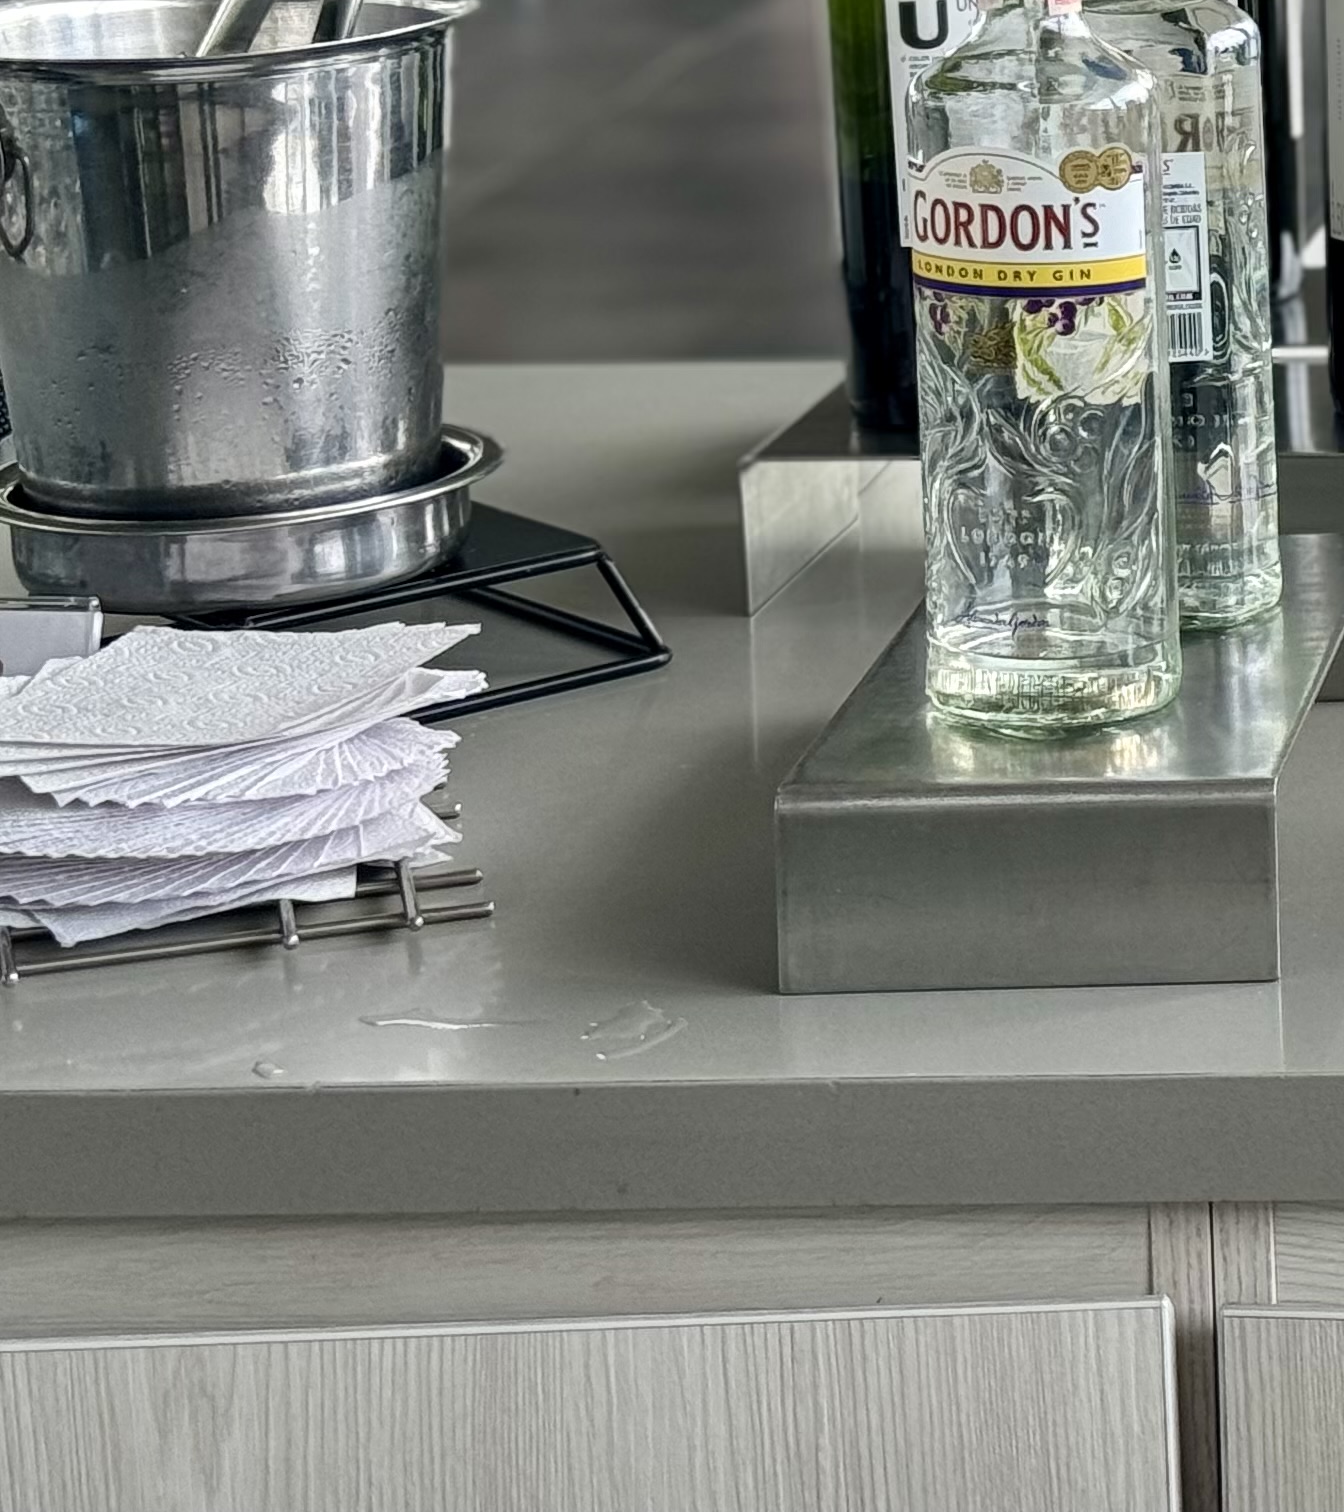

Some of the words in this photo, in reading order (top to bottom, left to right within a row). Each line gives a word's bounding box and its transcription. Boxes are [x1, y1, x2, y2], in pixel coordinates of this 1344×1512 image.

[913, 189, 1101, 251] GORDON'S
[917, 259, 984, 281] LONDON
[997, 269, 1037, 282] DRY
[1052, 268, 1092, 282] GIN
